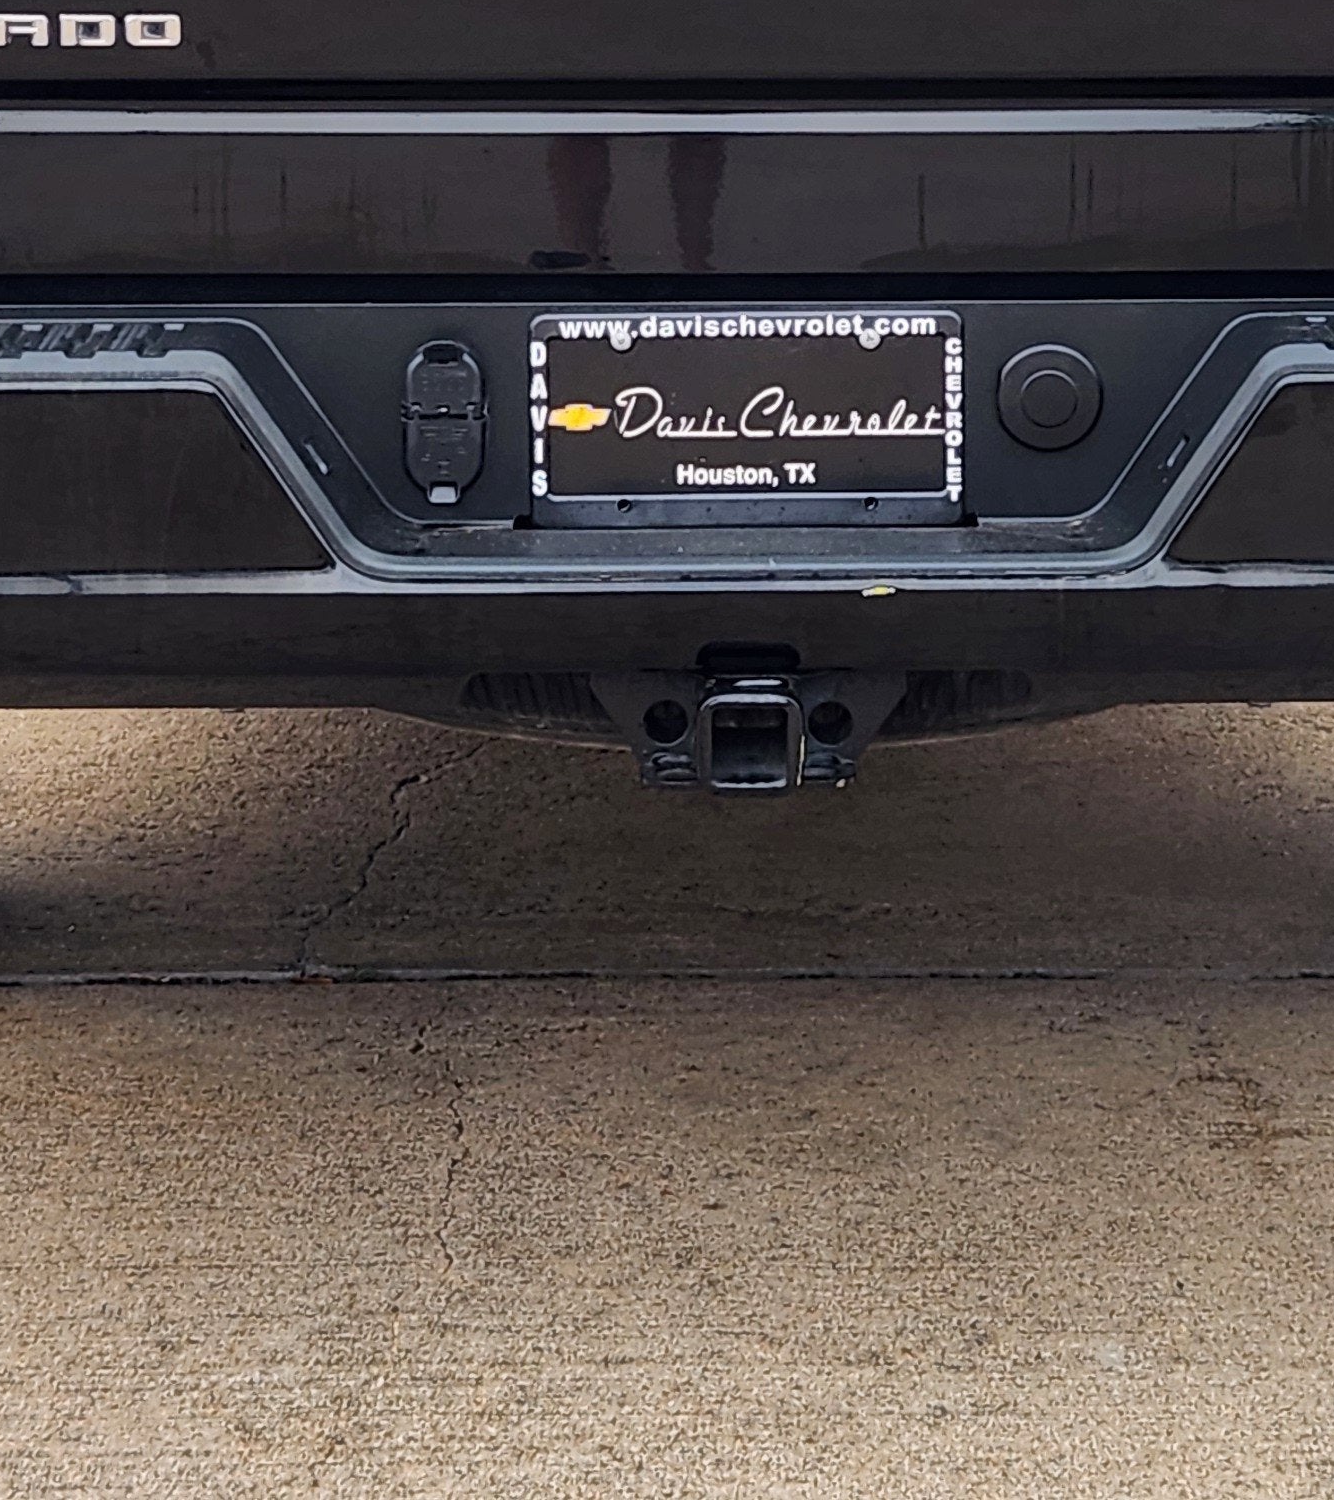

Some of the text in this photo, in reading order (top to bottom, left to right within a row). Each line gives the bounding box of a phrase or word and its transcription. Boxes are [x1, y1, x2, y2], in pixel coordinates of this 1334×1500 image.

[559, 314, 937, 340] www.davischevrolet.com
[529, 341, 548, 497] DAVIS
[613, 386, 946, 439] Davis Chevrolet
[944, 337, 964, 503] CHEVROLET
[676, 463, 816, 488] Houston, TX
